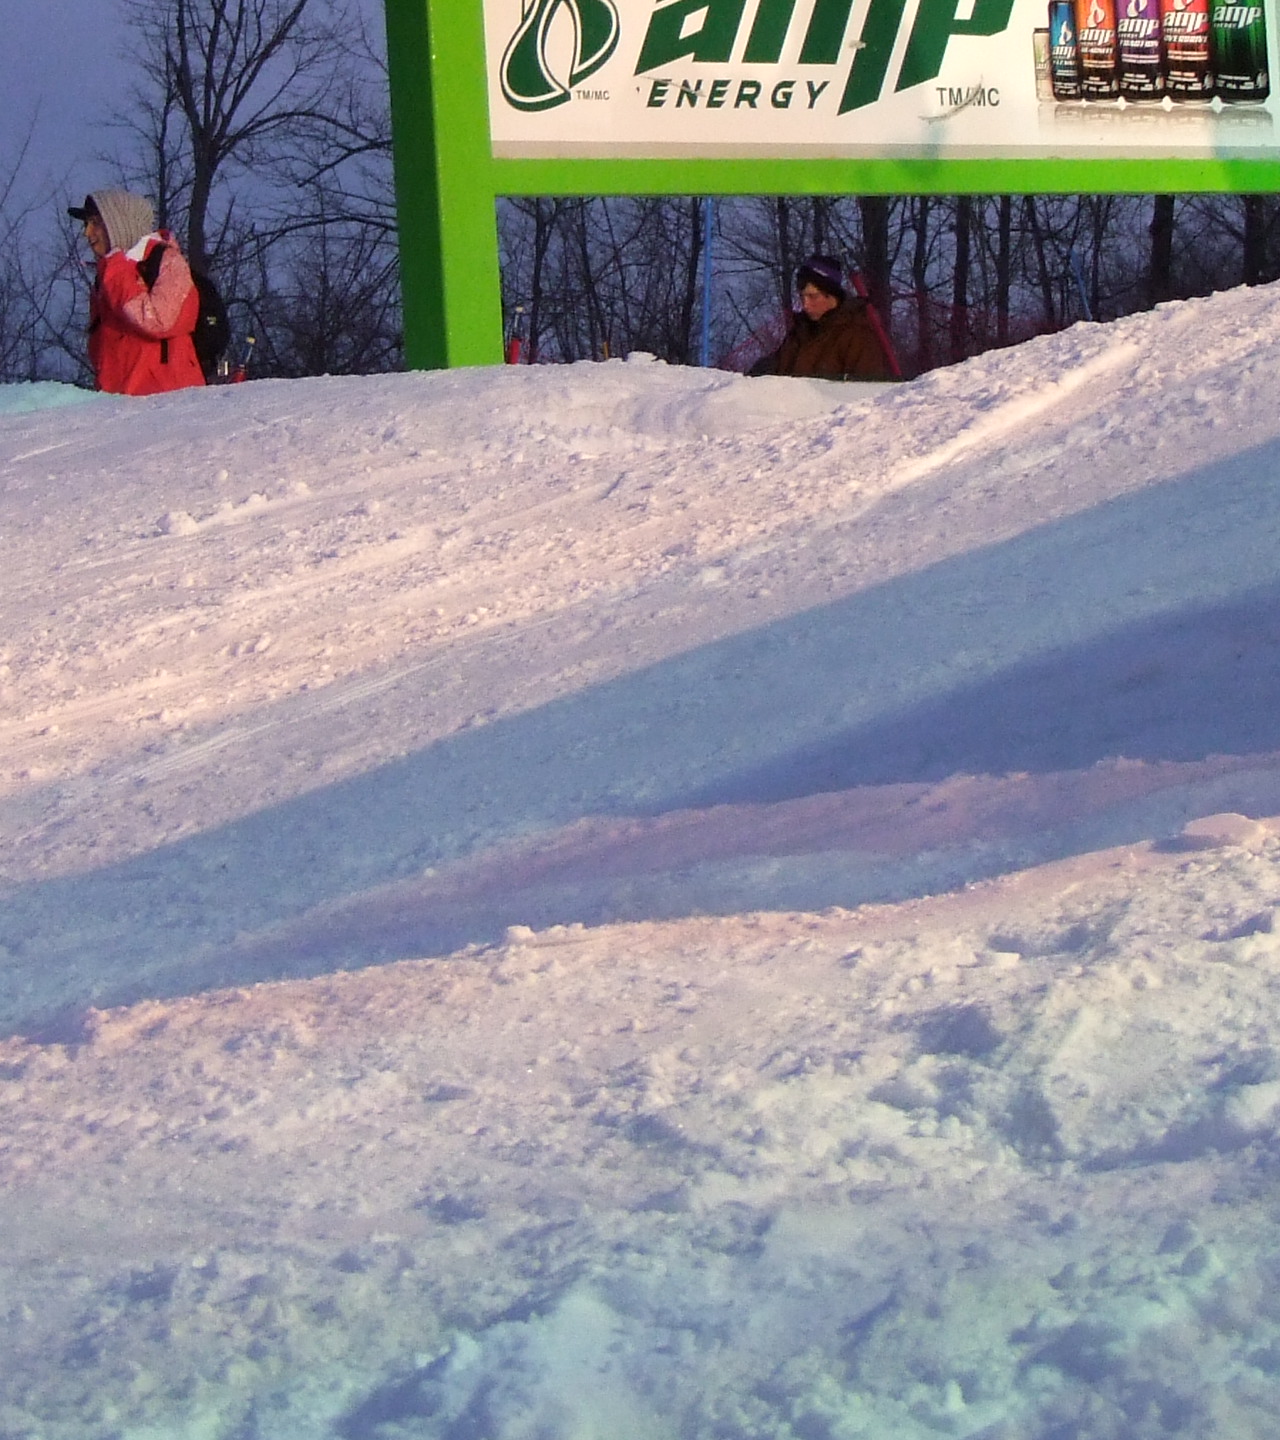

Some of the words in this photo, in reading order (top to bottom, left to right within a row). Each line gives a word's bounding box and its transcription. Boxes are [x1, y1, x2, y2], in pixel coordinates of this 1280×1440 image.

[1163, 11, 1209, 33] amp
[1213, 6, 1263, 29] amp
[1118, 19, 1159, 39] amp
[575, 89, 611, 101] TM/MC
[646, 78, 831, 109] ENERGY
[936, 86, 1000, 108] TM/MC
